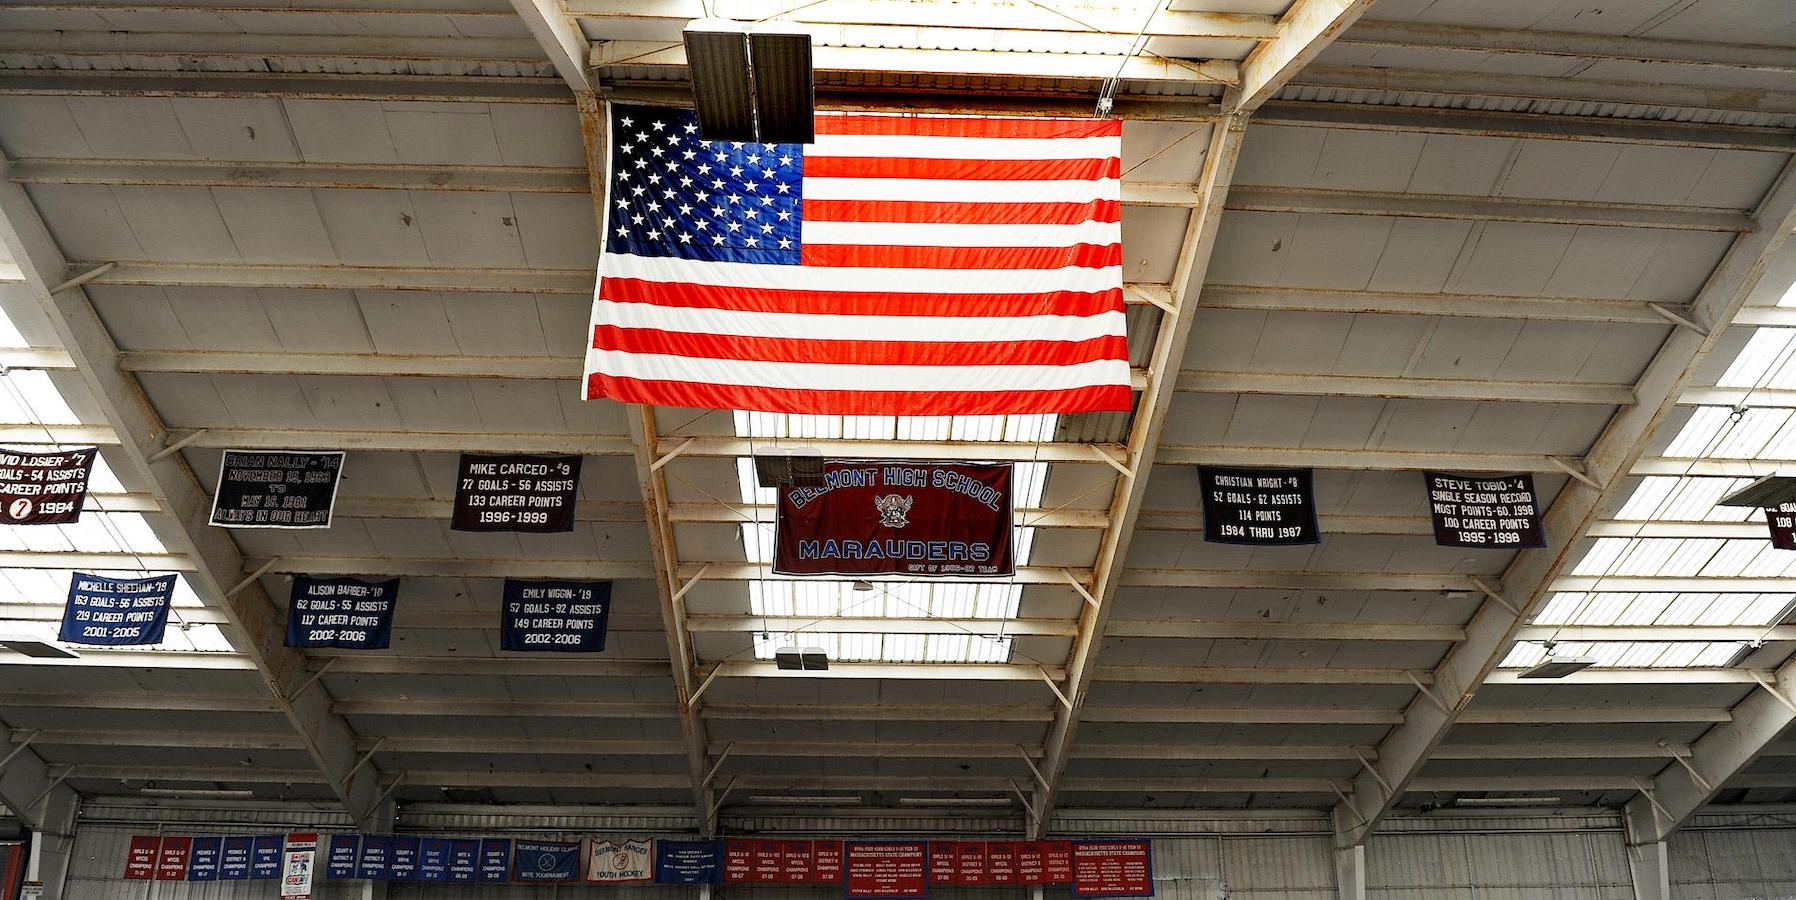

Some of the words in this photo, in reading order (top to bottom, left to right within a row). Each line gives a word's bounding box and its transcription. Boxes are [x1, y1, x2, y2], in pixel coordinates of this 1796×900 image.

[226, 456, 264, 468] BRIAN
[268, 456, 310, 468] NALLY
[46, 468, 86, 481] ASSISTS
[229, 469, 283, 482] NOVEMBER
[470, 464, 496, 475] MIKE
[500, 464, 547, 476] CARCEO
[463, 479, 474, 490] 77
[535, 480, 574, 491] ASSISTS
[1215, 475, 1253, 488] CHRISTIAN
[1257, 477, 1282, 488] WRIGHT
[1435, 478, 1472, 490] STEVE
[43, 482, 85, 495] POINTS
[270, 484, 286, 493] TO
[883, 467, 927, 487] HIGH
[932, 469, 1001, 511] SCHOOL
[241, 495, 262, 508] MAY
[282, 496, 307, 508] 1981
[469, 495, 486, 506] 133
[490, 496, 526, 506] CAREER
[528, 496, 562, 507] POINTS
[1213, 491, 1223, 502] 52
[1271, 494, 1302, 505] ASSISTS
[1432, 490, 1461, 502] SINGLE
[1464, 493, 1497, 504] SEASON
[1500, 492, 1532, 503] RECORD
[39, 501, 74, 514] 1984
[1434, 503, 1457, 515] MOST
[1514, 505, 1534, 516] 1998
[256, 509, 268, 522] IN
[270, 510, 291, 522] OUR
[294, 510, 328, 522] HEART
[1239, 510, 1252, 521] 114
[1256, 510, 1281, 521] POINTS
[1776, 516, 1792, 528] 108
[1444, 517, 1459, 529] 100
[1463, 519, 1497, 530] CAREER
[1500, 519, 1530, 530] POINTS
[1221, 525, 1245, 537] 1984
[1249, 527, 1274, 538] THRU
[1279, 526, 1301, 538] 1987
[798, 540, 990, 561] MARAUDERS
[908, 563, 925, 572] GIFT
[928, 564, 938, 572] OF
[979, 565, 998, 573] TEAM
[78, 580, 114, 593] MICHELLE
[308, 585, 335, 595] ALISON
[523, 588, 545, 599] EMILY
[74, 594, 88, 606] 163
[132, 596, 165, 608] ASSISTS
[296, 599, 308, 610] 62
[355, 601, 388, 612] ASSISTS
[509, 602, 520, 613] 57
[569, 604, 601, 615] ASSISTS
[76, 610, 90, 621] 219
[92, 611, 124, 623] CAREER
[126, 611, 154, 622] POINTS
[301, 615, 315, 625] 117
[318, 614, 348, 625] CAREER
[350, 616, 378, 626] POINTS
[514, 618, 529, 629] 149
[532, 618, 563, 629] CAREER
[566, 619, 594, 630] POINTS
